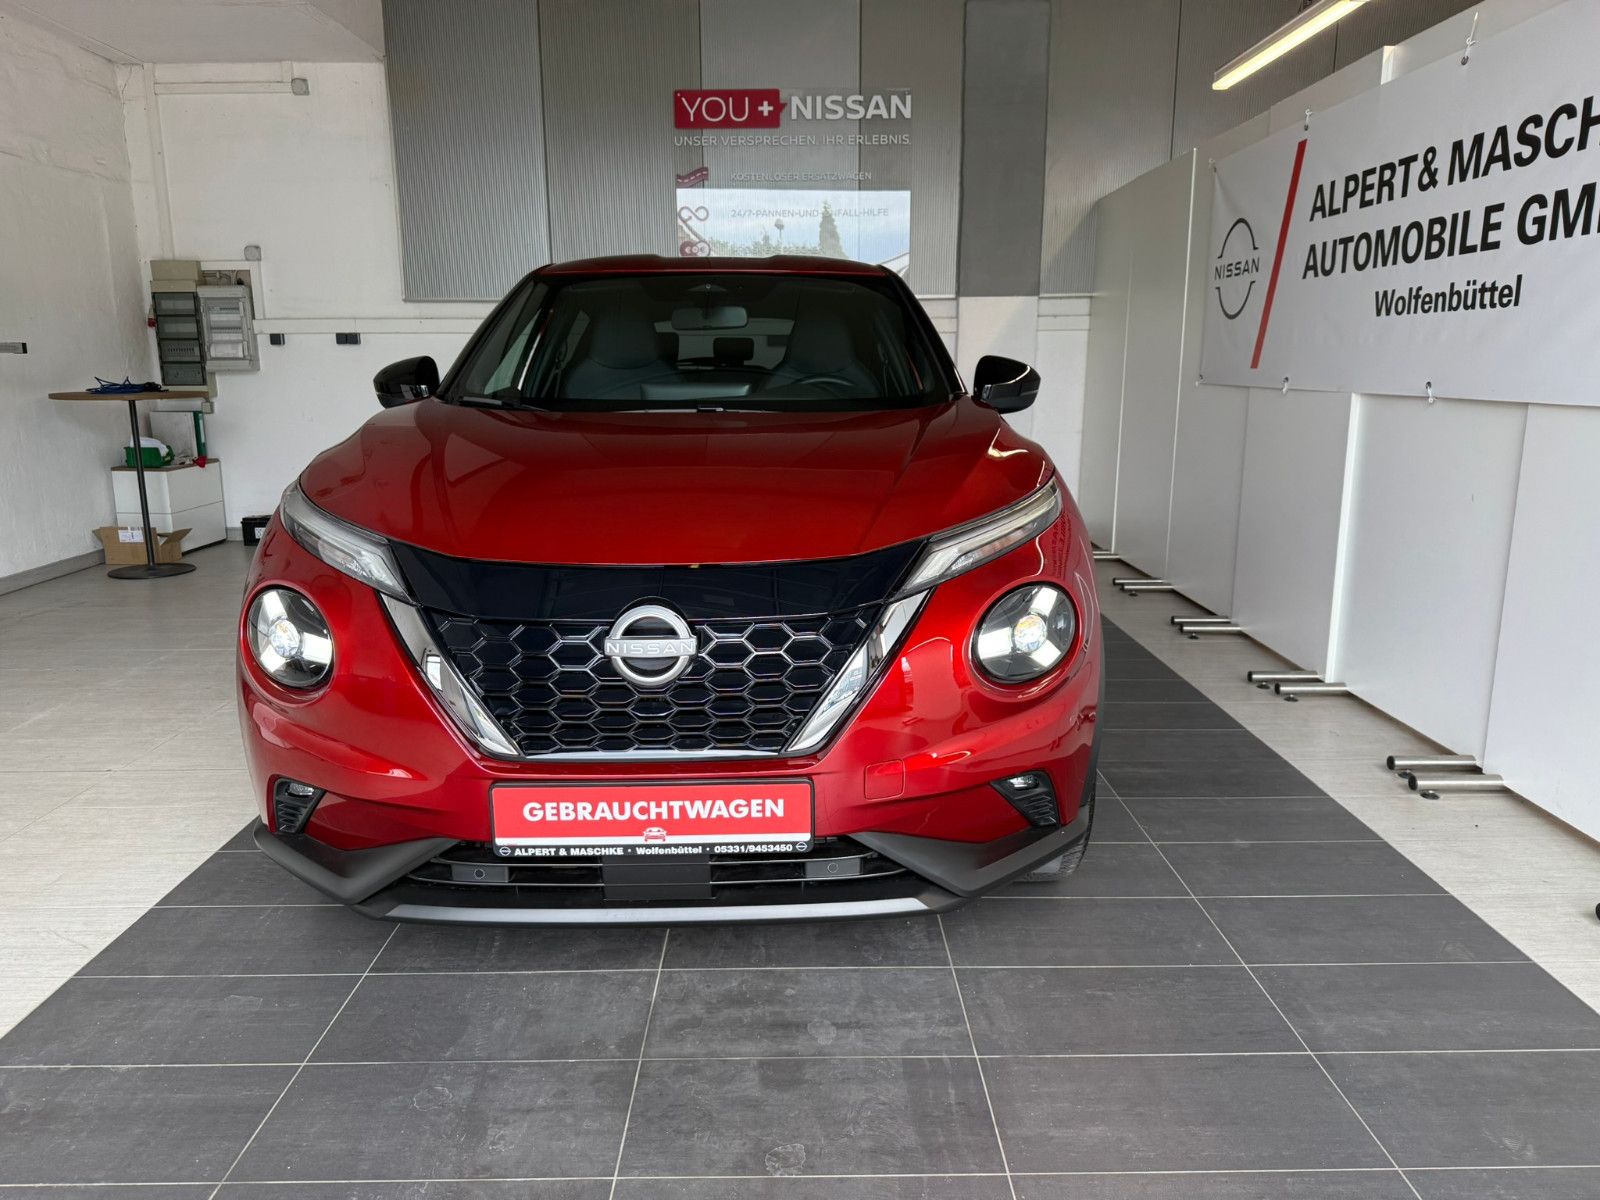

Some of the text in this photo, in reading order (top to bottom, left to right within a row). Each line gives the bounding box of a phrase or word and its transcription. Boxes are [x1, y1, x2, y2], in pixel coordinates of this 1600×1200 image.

[681, 96, 749, 122] YOU
[790, 94, 912, 120] NISSAN
[674, 135, 718, 147] UNSER
[822, 134, 844, 145] IHR
[848, 133, 912, 146] ERLEBNIS.
[730, 171, 872, 182] KOSTENLOSER ERSATZWAGEN
[1310, 154, 1418, 222] ALPERT
[1417, 146, 1438, 193] &
[1302, 181, 1600, 280] AUTOMOBILE GM
[1214, 257, 1260, 281] NISSAN
[1375, 274, 1523, 317] Wolfenbüttel
[606, 642, 694, 654] NISSAN
[522, 798, 785, 823] GEBRAUCHTWAGEN
[514, 844, 793, 856] ALPERT & MASCHKE Wolfenbüttel 05331/9453450
